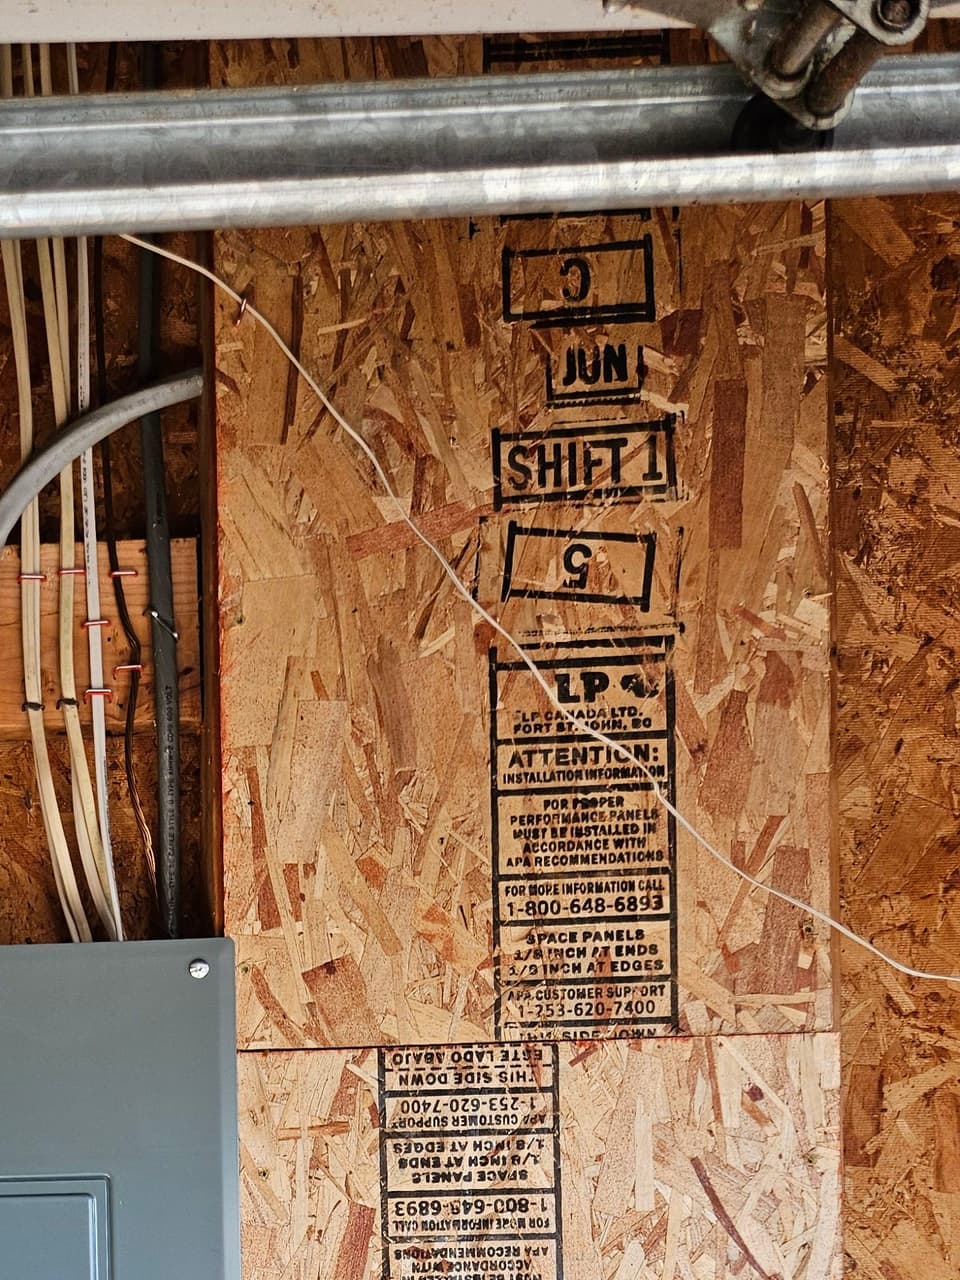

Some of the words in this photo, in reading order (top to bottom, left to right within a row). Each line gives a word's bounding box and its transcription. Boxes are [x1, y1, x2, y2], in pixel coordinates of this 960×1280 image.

[562, 344, 628, 385] JUN
[507, 436, 628, 491] SHIFT
[643, 435, 662, 482] 1
[564, 544, 592, 589] 5
[556, 672, 609, 703] LP
[165, 685, 173, 705] VOLT
[544, 708, 607, 721] CANADA
[611, 706, 642, 717] LTD.
[513, 723, 553, 734] FORT
[556, 721, 578, 732] ST.
[508, 743, 659, 768] ATTENTION:
[503, 769, 583, 785] INSTALLATION
[584, 765, 665, 781] INFORMATION
[544, 799, 568, 810] FOR
[573, 796, 624, 809] PROPER
[510, 811, 606, 826] PERFORMANCE
[609, 809, 658, 821] PANELS
[513, 828, 548, 839] MUST
[551, 828, 568, 838] BE
[571, 824, 640, 837] INSTALLED
[643, 823, 656, 834] IN
[523, 839, 609, 853] ACCORDANCE
[613, 837, 646, 849] WITH
[506, 857, 531, 867] APA
[535, 851, 664, 867] RECOMMENDATIONS
[505, 885, 526, 897] FOR
[529, 884, 560, 896] MORE
[562, 881, 635, 895] INFORMATION
[639, 880, 665, 891] CALL
[507, 896, 663, 916] 1-800-648-6893
[526, 932, 578, 945] SPACE
[583, 929, 645, 943] PANELS
[548, 947, 586, 960] INCH
[616, 944, 658, 957] ENDS
[543, 963, 582, 975] INCH
[586, 961, 606, 973] AT
[611, 959, 664, 972] EDGES
[535, 987, 603, 1000] CUSTOMER
[517, 1001, 656, 1018] 1-253-620-7400
[392, 1052, 445, 1065] ABAJO
[451, 1051, 494, 1063] LADO
[500, 1049, 543, 1062] ESTE
[399, 1073, 447, 1086] DOWN
[453, 1072, 492, 1085] SIDE
[401, 1097, 536, 1114] 1-253-620-7400
[451, 1115, 518, 1127] CUSTOMER
[393, 1141, 445, 1154] EDGES
[449, 1140, 468, 1153] AT
[472, 1140, 511, 1152] INCH
[398, 1157, 441, 1169] ENDS
[444, 1156, 464, 1167] AT
[466, 1155, 507, 1166] INCH
[411, 1172, 473, 1184] PANELS
[477, 1170, 529, 1182] SPACE
[394, 1197, 547, 1216] 1-800-648-6893
[392, 1221, 418, 1232] CALL
[421, 1218, 493, 1231] INFORMATION
[496, 1218, 526, 1229] MORE
[529, 1218, 549, 1229] FOR
[394, 1246, 521, 1261] RECOMMENDATIONS
[524, 1246, 549, 1259] APA
[411, 1261, 442, 1273] WITH
[446, 1259, 531, 1272] ACCORDANCE
